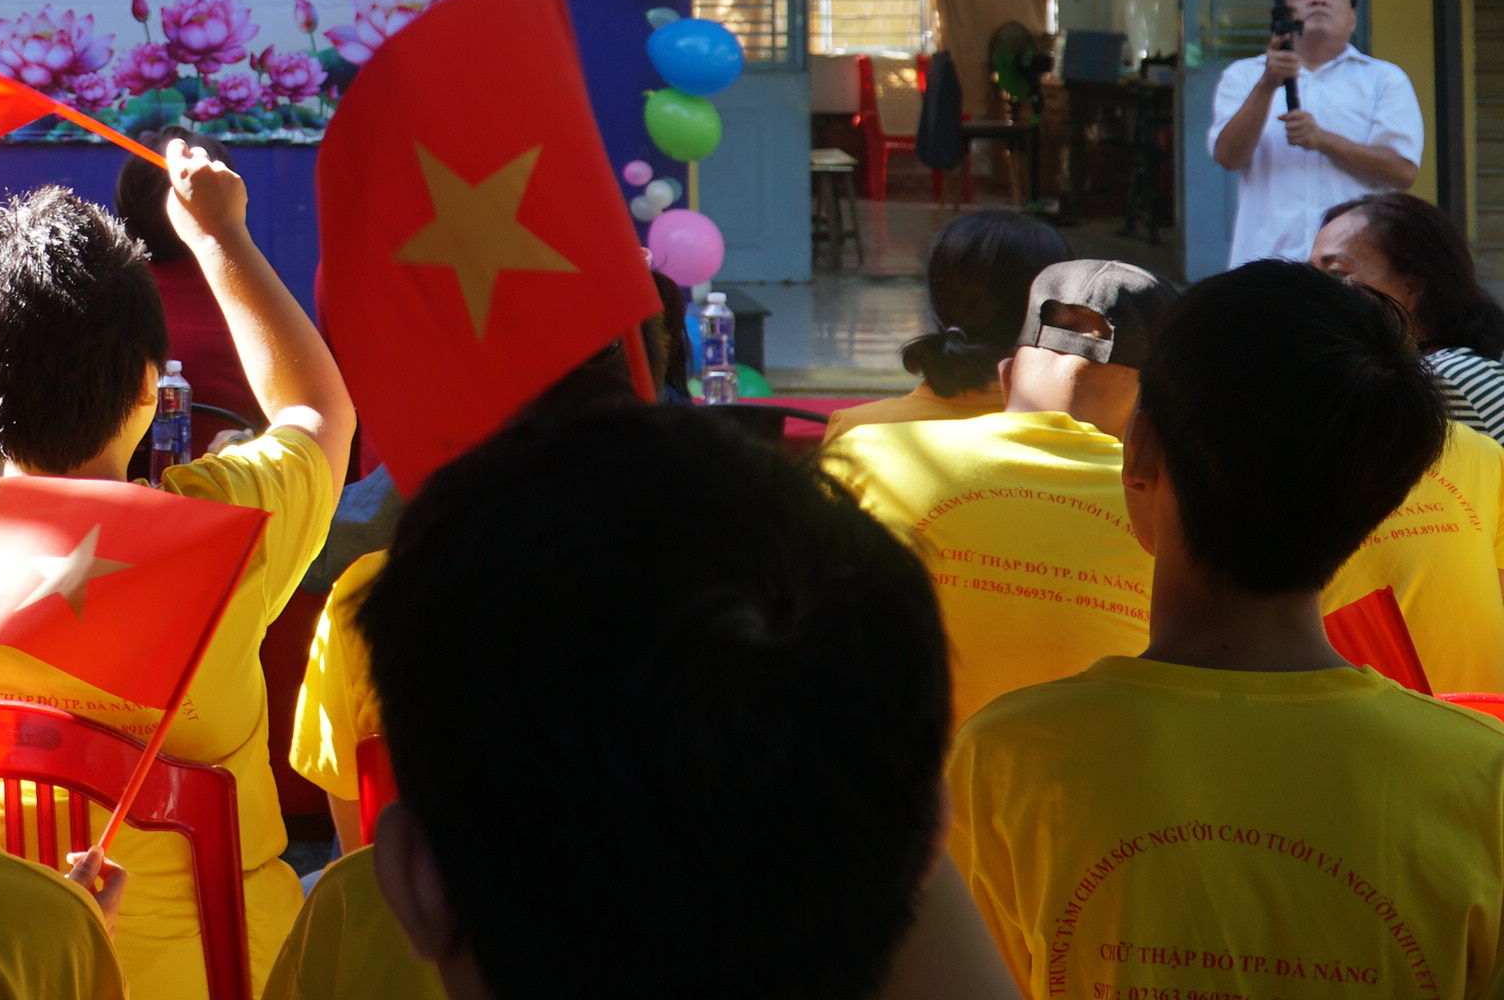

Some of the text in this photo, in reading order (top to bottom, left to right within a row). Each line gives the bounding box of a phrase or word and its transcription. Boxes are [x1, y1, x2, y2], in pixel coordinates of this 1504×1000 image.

[928, 495, 963, 520] CHĂM
[962, 487, 989, 503] SÓC
[989, 486, 1035, 500] NGƯỜI
[1037, 490, 1067, 505] CAO
[1069, 497, 1104, 520] TUỔI
[1104, 511, 1123, 527] VÀ
[1390, 522, 1461, 540] 0934.891683
[940, 547, 1146, 595] CHỮ THẬP ĐỎ TP. ĐÀ NẴNG
[971, 578, 1064, 604] 02363.969376
[1075, 593, 1151, 623] 0934.891683
[61, 698, 84, 710] TP.
[85, 699, 108, 711] ĐÀ
[1048, 818, 1439, 996] TRUNG TÂM CHĂM SÓC NGƯỜI CAO TUỔI VÀ NGƯỜI KHUYẾT
[1099, 940, 1380, 986] CHỮ THẬP ĐỎ TP. ĐÀ NẴNG
